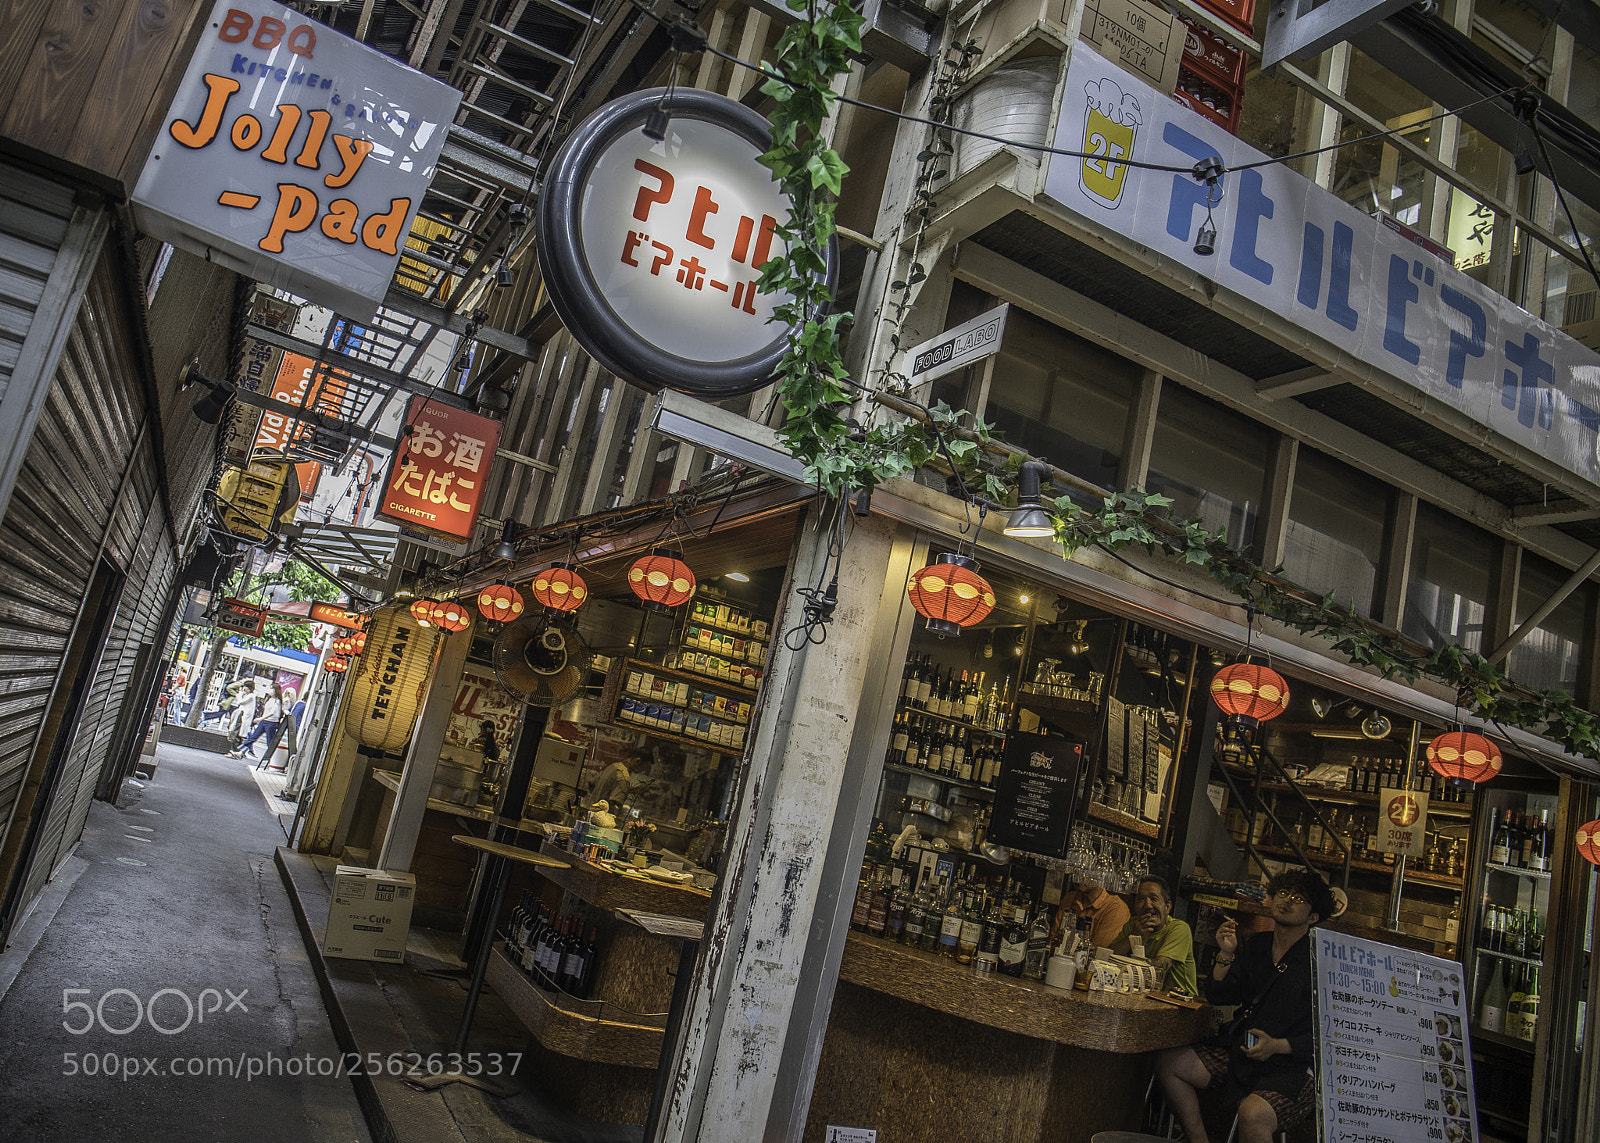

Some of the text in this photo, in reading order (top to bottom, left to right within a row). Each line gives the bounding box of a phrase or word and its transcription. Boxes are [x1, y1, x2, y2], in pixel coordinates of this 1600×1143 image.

[218, 9, 317, 59] BBQ
[1126, 11, 1147, 34] 10個
[230, 53, 333, 91] KITCHEN
[169, 73, 375, 189] Jolly
[1085, 132, 1125, 180] 2F
[633, 158, 777, 272] アヒル
[620, 230, 757, 316] ビアホール
[915, 323, 996, 373] FOOD LABO
[418, 404, 449, 420] LIQUOR
[408, 421, 486, 473] お酒
[393, 460, 475, 513] たばこ
[389, 502, 437, 522] CIGARETTE
[371, 626, 411, 720] TETCHAN
[1386, 840, 1412, 849] あります
[1388, 829, 1413, 841] 30席
[368, 913, 392, 926] Cute
[1322, 940, 1394, 971] アヒルビアホール
[1324, 1014, 1331, 1038] 2
[1326, 1042, 1333, 1066] 3
[1326, 1070, 1334, 1094] 4
[1336, 1074, 1396, 1093] イタリアンハンバーグ
[1329, 1097, 1336, 1122] 5
